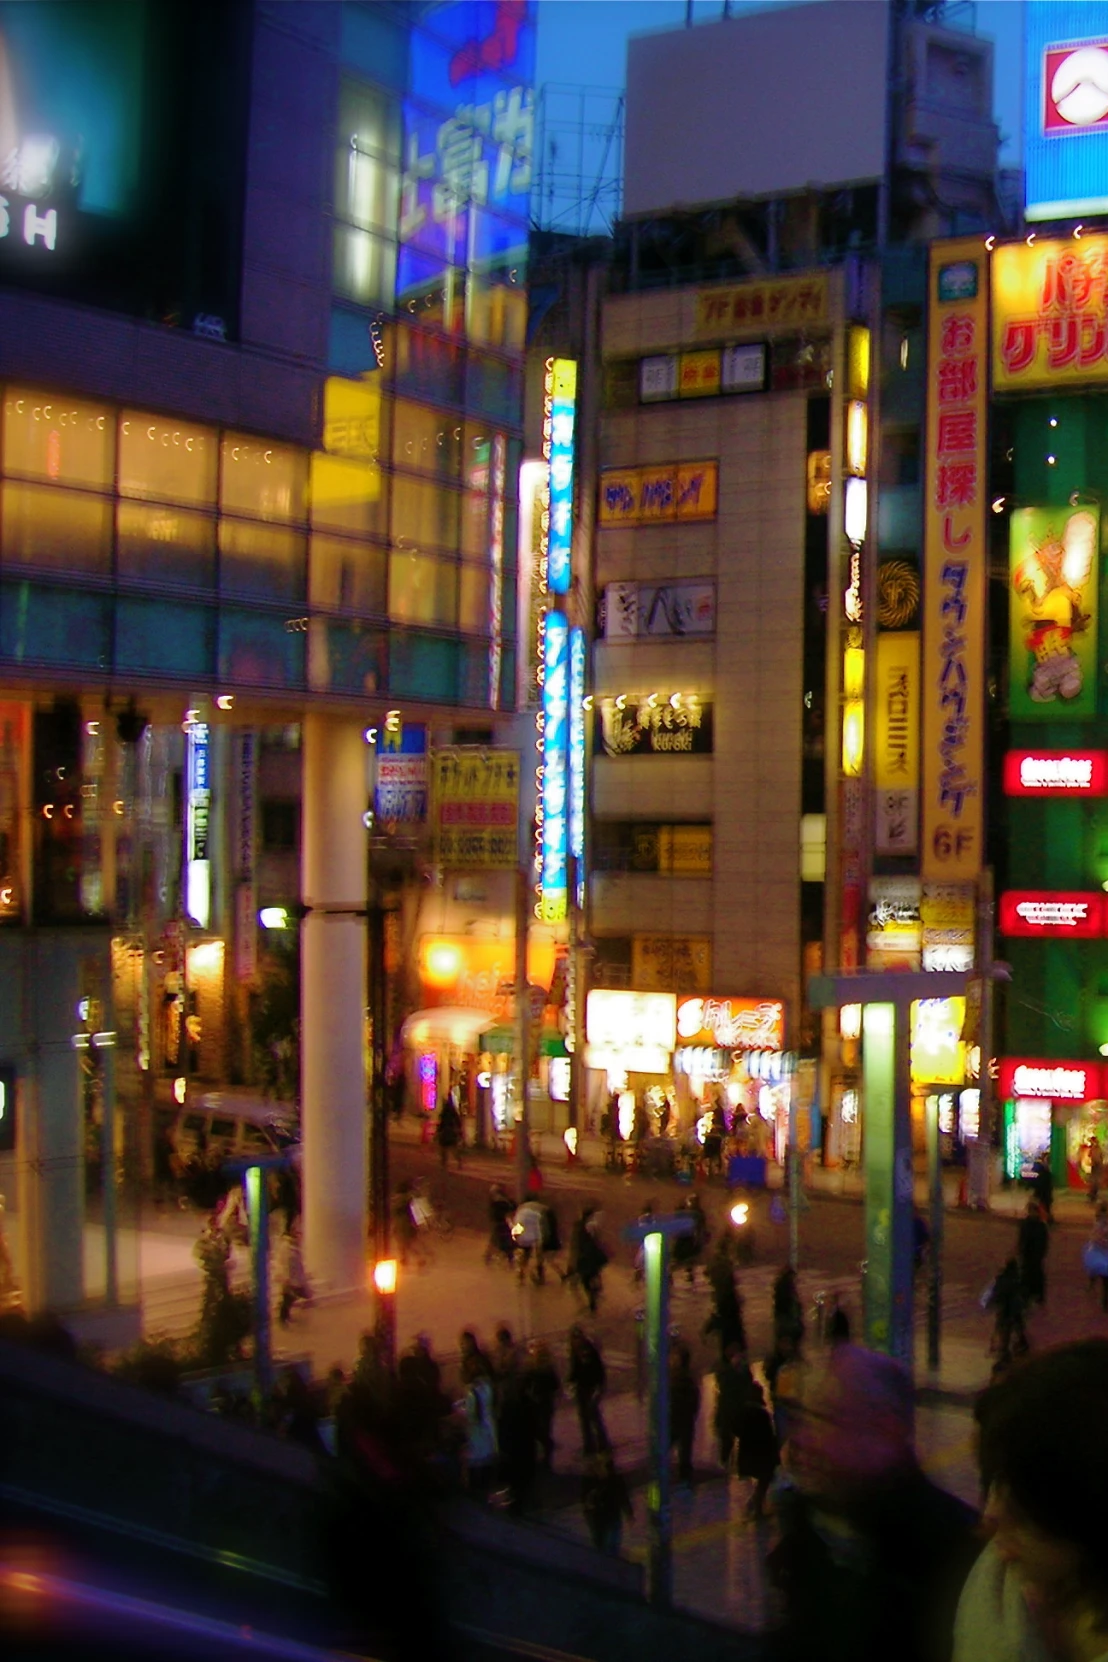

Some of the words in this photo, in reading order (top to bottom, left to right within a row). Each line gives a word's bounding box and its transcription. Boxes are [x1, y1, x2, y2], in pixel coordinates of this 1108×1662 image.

[936, 315, 979, 554] お部屋探し
[933, 822, 975, 863] 6F
